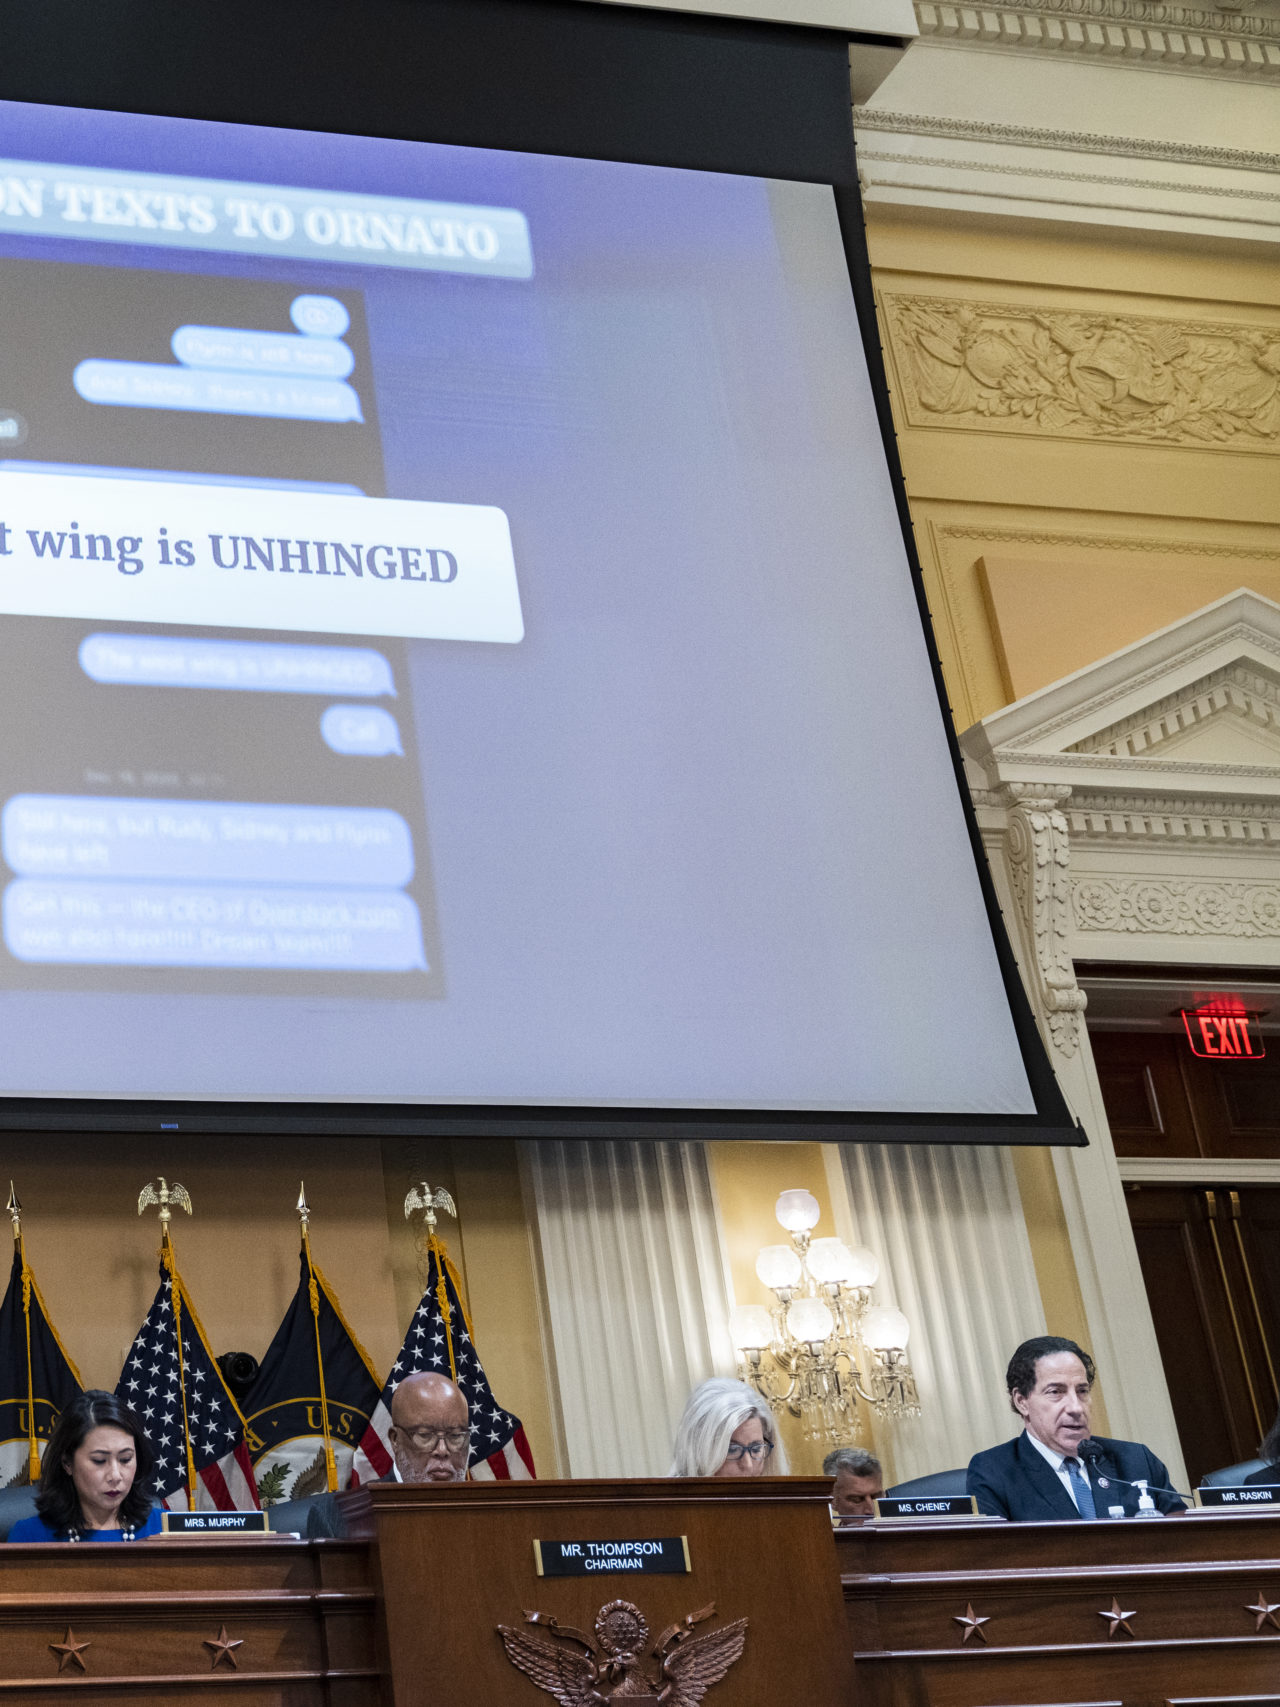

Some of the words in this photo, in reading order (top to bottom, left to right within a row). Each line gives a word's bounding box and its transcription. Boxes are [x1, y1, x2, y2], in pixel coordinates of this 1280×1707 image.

[55, 183, 217, 236] TEXTS
[225, 199, 294, 242] TO
[305, 208, 499, 262] ORNATO
[26, 521, 144, 576] wing
[158, 527, 197, 566] is
[208, 534, 458, 583] UNHINGED
[1199, 1016, 1253, 1055] EXIT
[1222, 1492, 1239, 1501] MR.
[1240, 1491, 1273, 1501] RASKIN
[898, 1503, 915, 1512] MS.
[915, 1502, 951, 1512] CHENEY
[184, 1518, 207, 1528] MRS.
[208, 1517, 246, 1527] MURPHY
[560, 1544, 585, 1557] MR.
[587, 1542, 663, 1556] THOMPSON
[584, 1558, 643, 1570] CHAIRMAN
